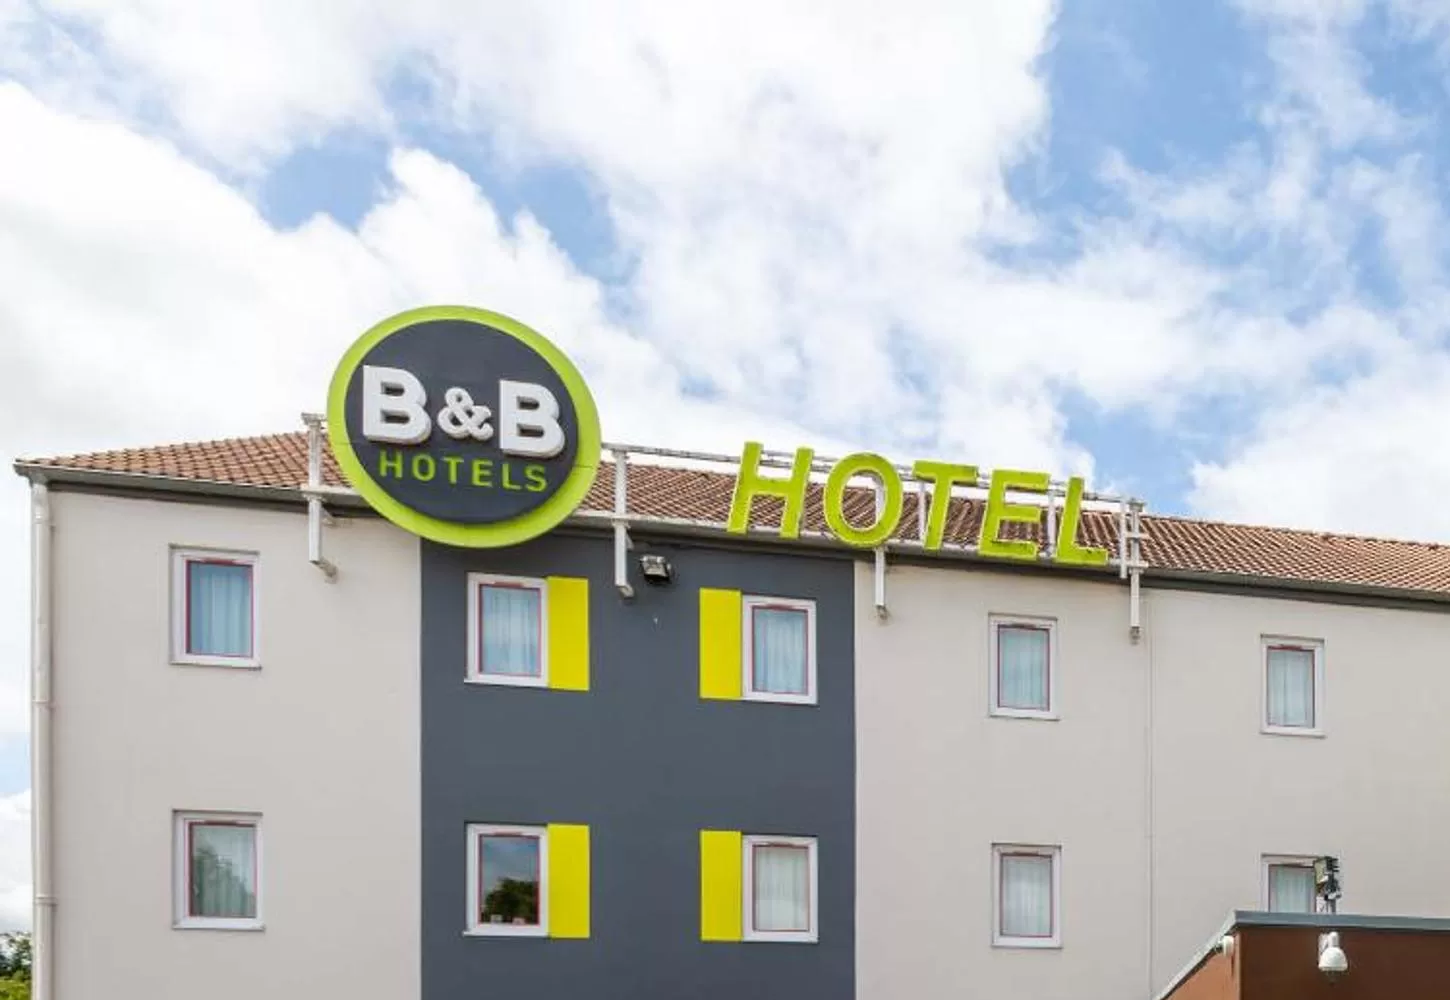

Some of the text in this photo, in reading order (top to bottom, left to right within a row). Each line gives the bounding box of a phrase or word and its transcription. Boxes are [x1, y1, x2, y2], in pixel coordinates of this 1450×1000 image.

[363, 365, 566, 458] B&B
[378, 450, 549, 493] HOTELS
[727, 441, 1108, 566] HOTEL
